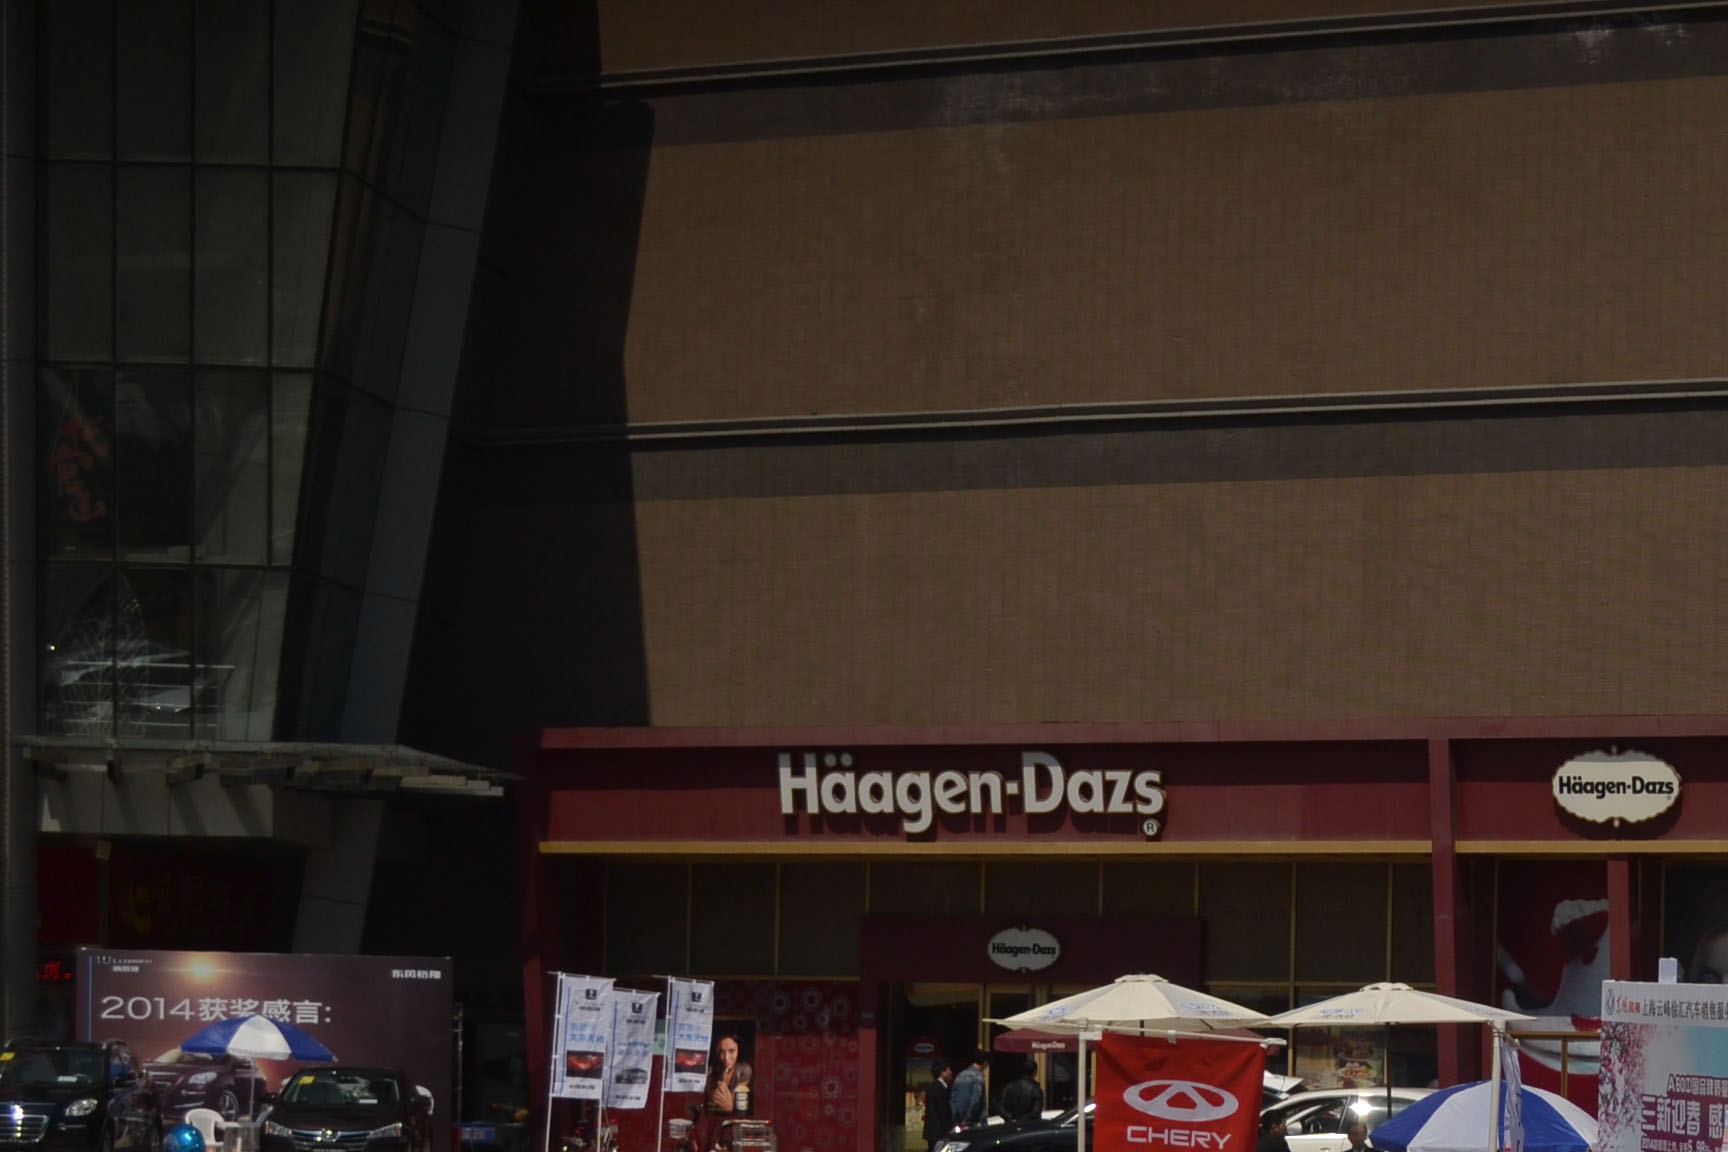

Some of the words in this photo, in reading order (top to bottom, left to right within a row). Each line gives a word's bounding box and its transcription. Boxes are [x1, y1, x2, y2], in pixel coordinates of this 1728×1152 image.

[777, 750, 1166, 834] Häagen-Dazs
[1558, 775, 1674, 799] Häagen-Dazs
[991, 943, 1057, 957] Häagen-Dazs
[1641, 1095, 1701, 1136] 三新迎春
[1126, 1125, 1232, 1150] CHERY
